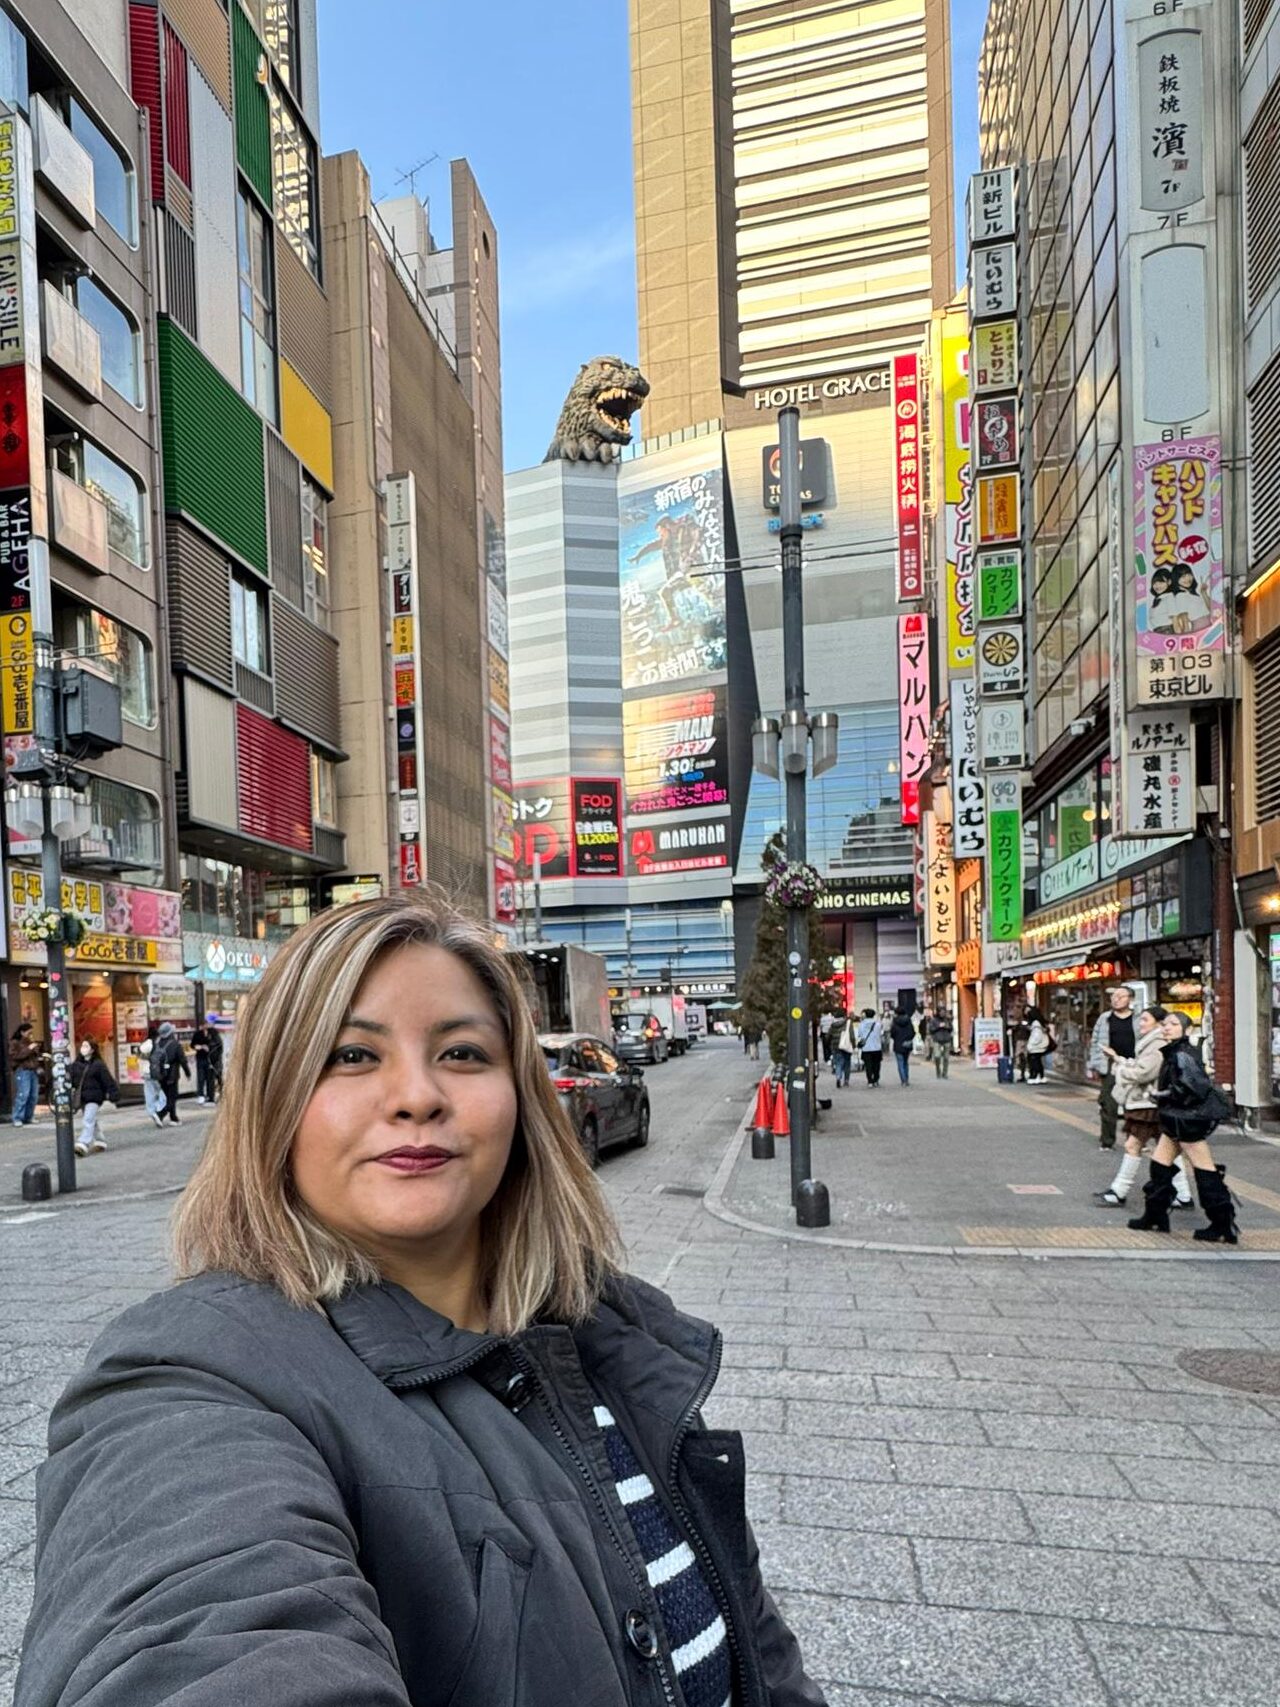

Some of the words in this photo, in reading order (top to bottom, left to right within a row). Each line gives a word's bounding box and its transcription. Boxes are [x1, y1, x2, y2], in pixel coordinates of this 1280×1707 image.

[1159, 53, 1180, 114] 鉄板焼
[982, 173, 1003, 235] 川新ビル
[985, 252, 1003, 310] にいむら
[754, 383, 819, 409] HOTEL
[1178, 460, 1205, 524] ハンド
[1149, 674, 1213, 700] 東京ビル
[903, 640, 926, 779] マルハン
[1132, 734, 1186, 750] ルノアール
[580, 795, 613, 808] FOD
[958, 758, 985, 853] にいむら
[659, 824, 726, 849] MARUHAN
[845, 891, 911, 907] CINEMAS
